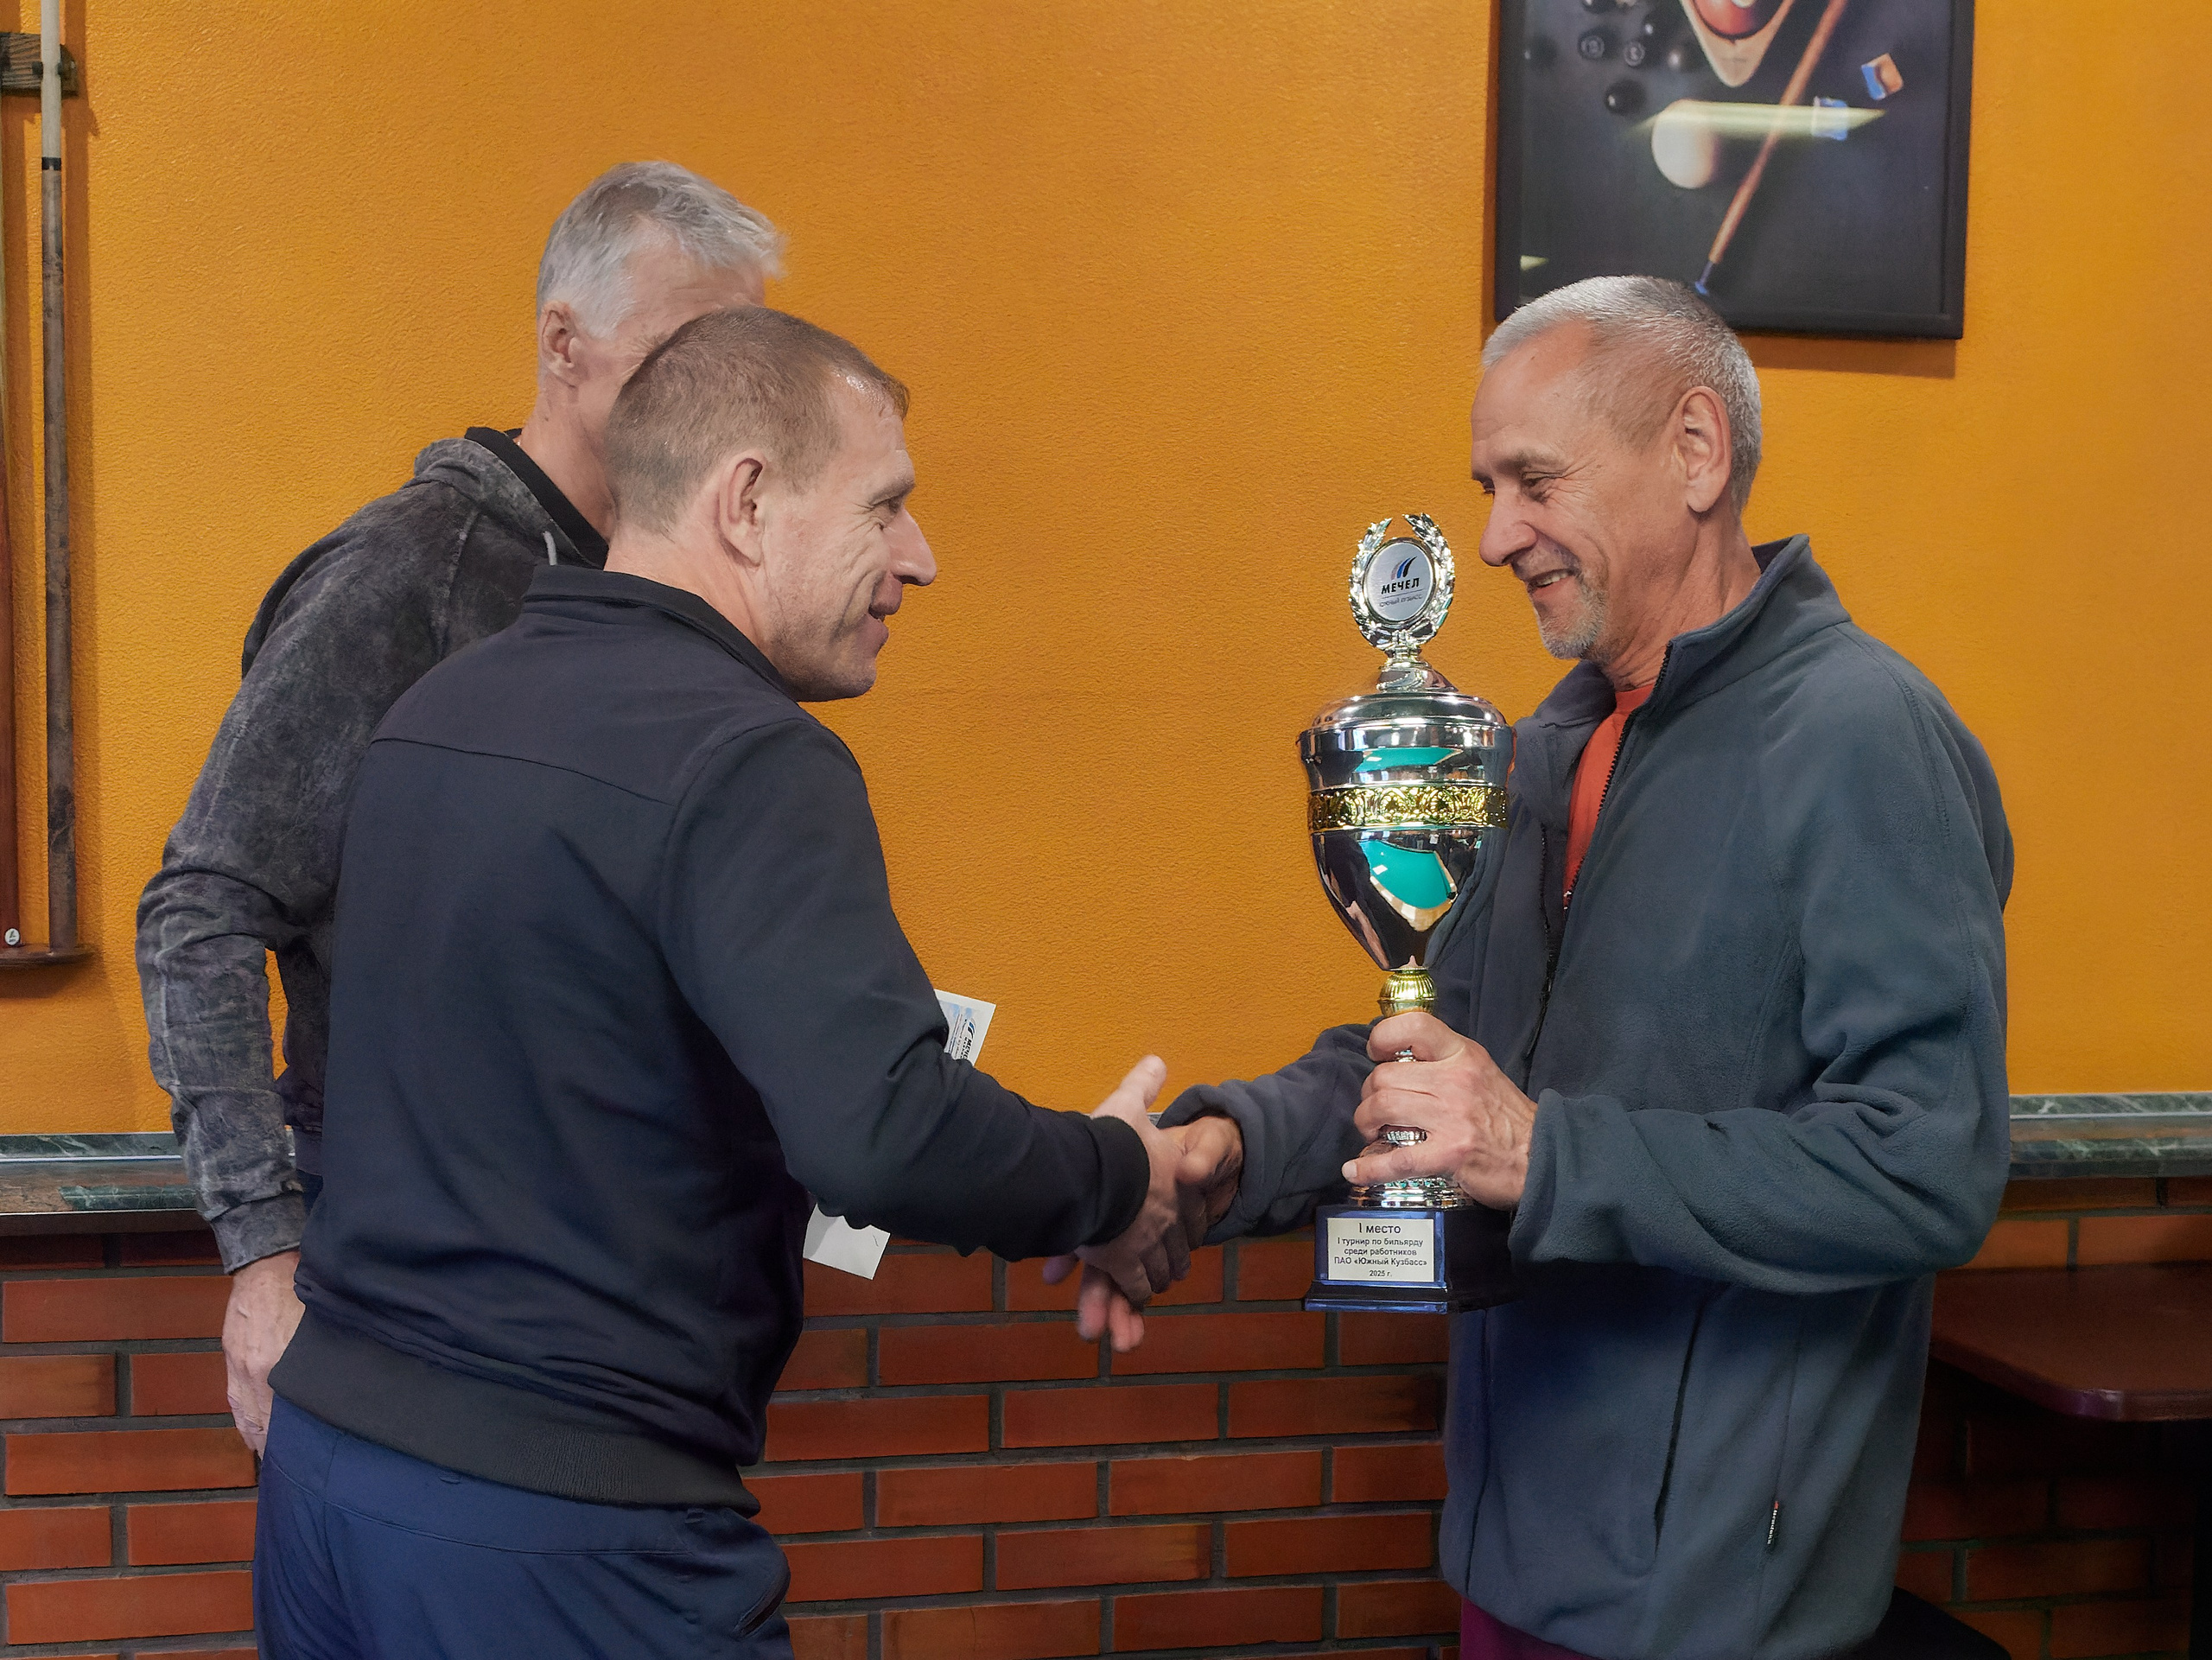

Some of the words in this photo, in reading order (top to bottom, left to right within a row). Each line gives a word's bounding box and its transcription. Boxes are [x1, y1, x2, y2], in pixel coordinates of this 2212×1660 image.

[1381, 578, 1419, 595] МЕЧЕЛ
[1384, 1238, 1423, 1247] бильярду
[1370, 1248, 1417, 1256] работников
[1391, 1258, 1427, 1267] Кузбасс»
